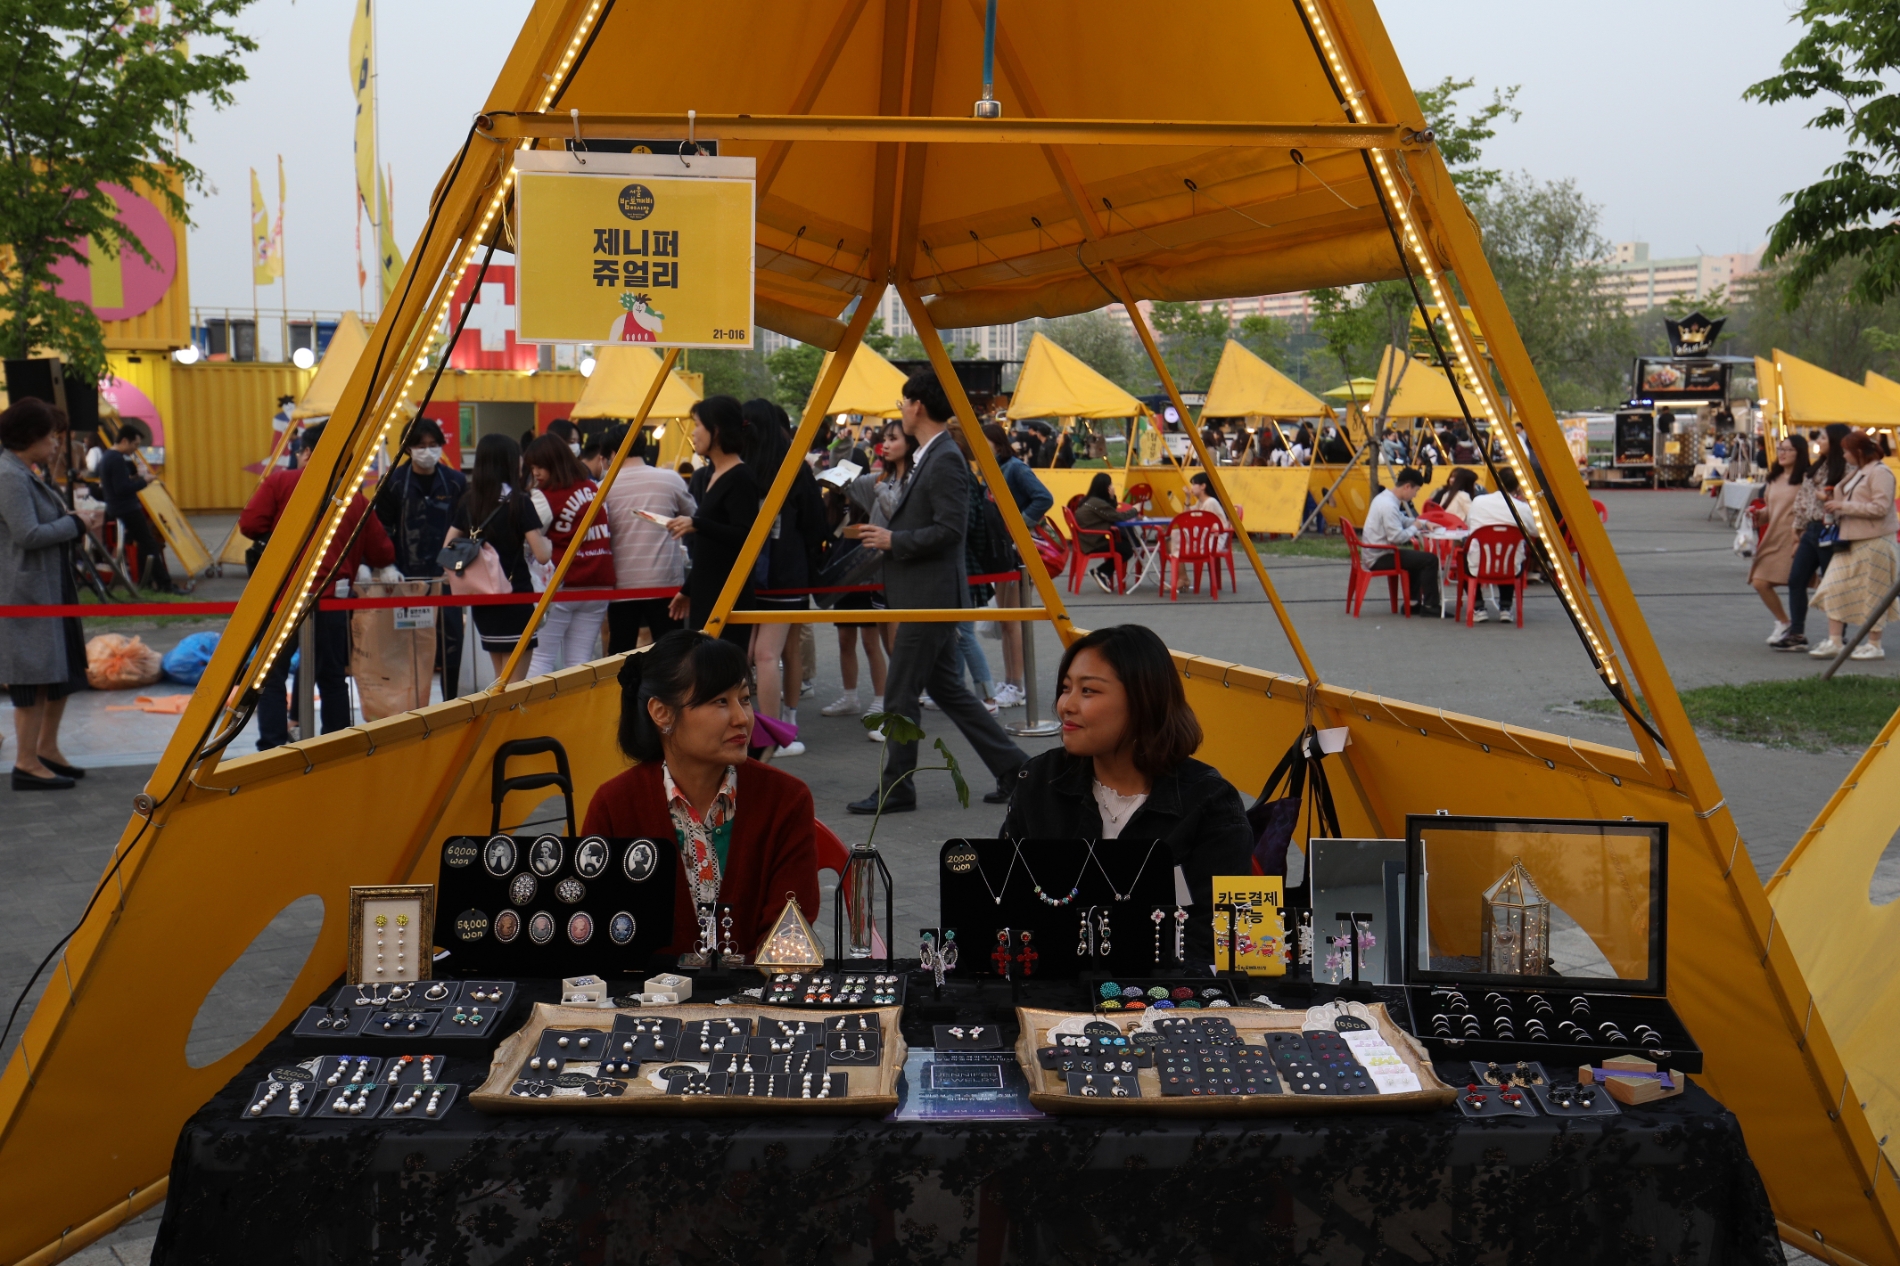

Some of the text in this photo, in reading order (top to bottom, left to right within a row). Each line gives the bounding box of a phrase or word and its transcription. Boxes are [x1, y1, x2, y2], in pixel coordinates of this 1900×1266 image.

[593, 228, 679, 258] 제니퍼
[593, 259, 679, 289] 쥬얼리
[713, 329, 745, 340] 21-016
[447, 846, 477, 856] 60,000
[952, 863, 971, 871] won
[1218, 891, 1278, 906] 카드결제
[457, 919, 488, 930] 54,000
[462, 931, 483, 940] won
[1336, 1021, 1367, 1030] 10,000
